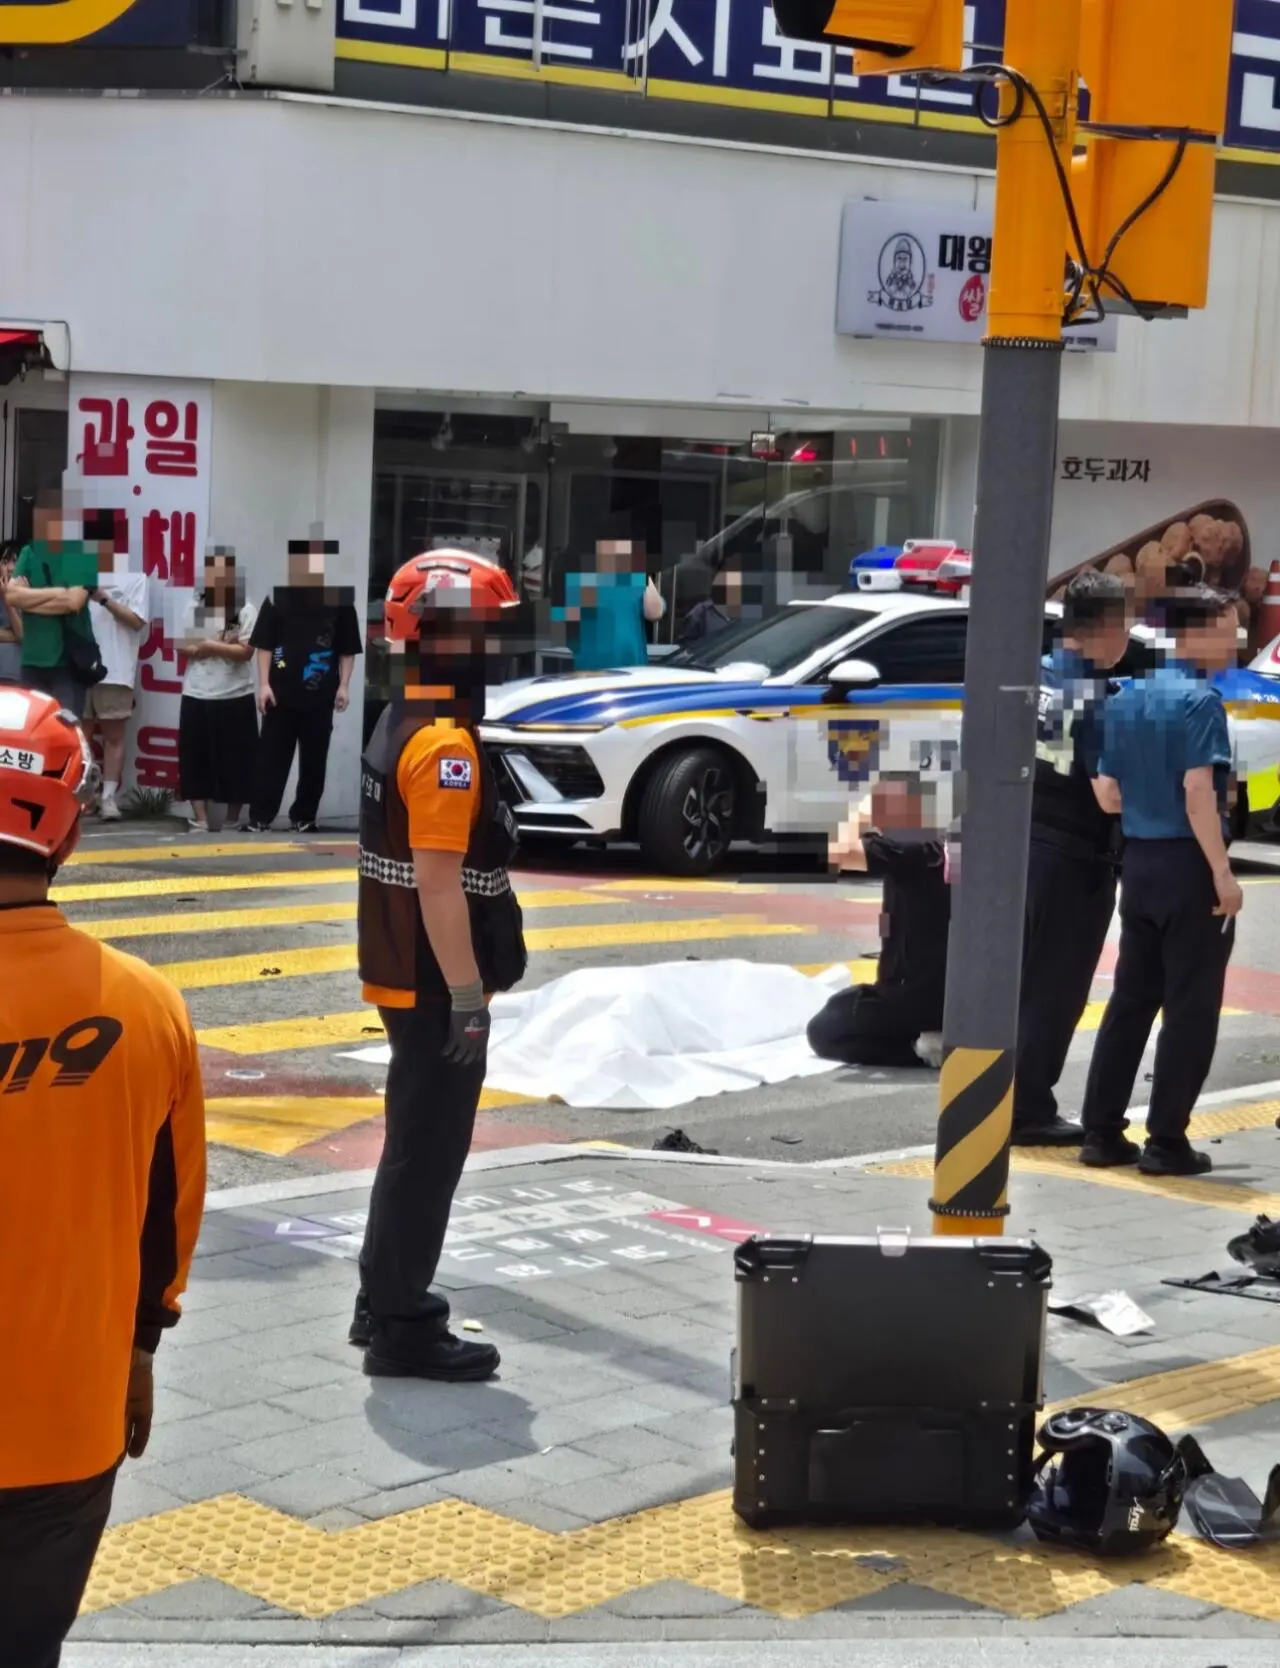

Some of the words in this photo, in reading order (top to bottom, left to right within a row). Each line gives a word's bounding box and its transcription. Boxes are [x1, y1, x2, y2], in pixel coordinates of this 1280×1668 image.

[964, 287, 985, 319] 쌀
[79, 397, 198, 477] 과일
[1061, 456, 1151, 482] 호두과자
[0, 748, 35, 770] 소방
[444, 780, 468, 788] KOREA
